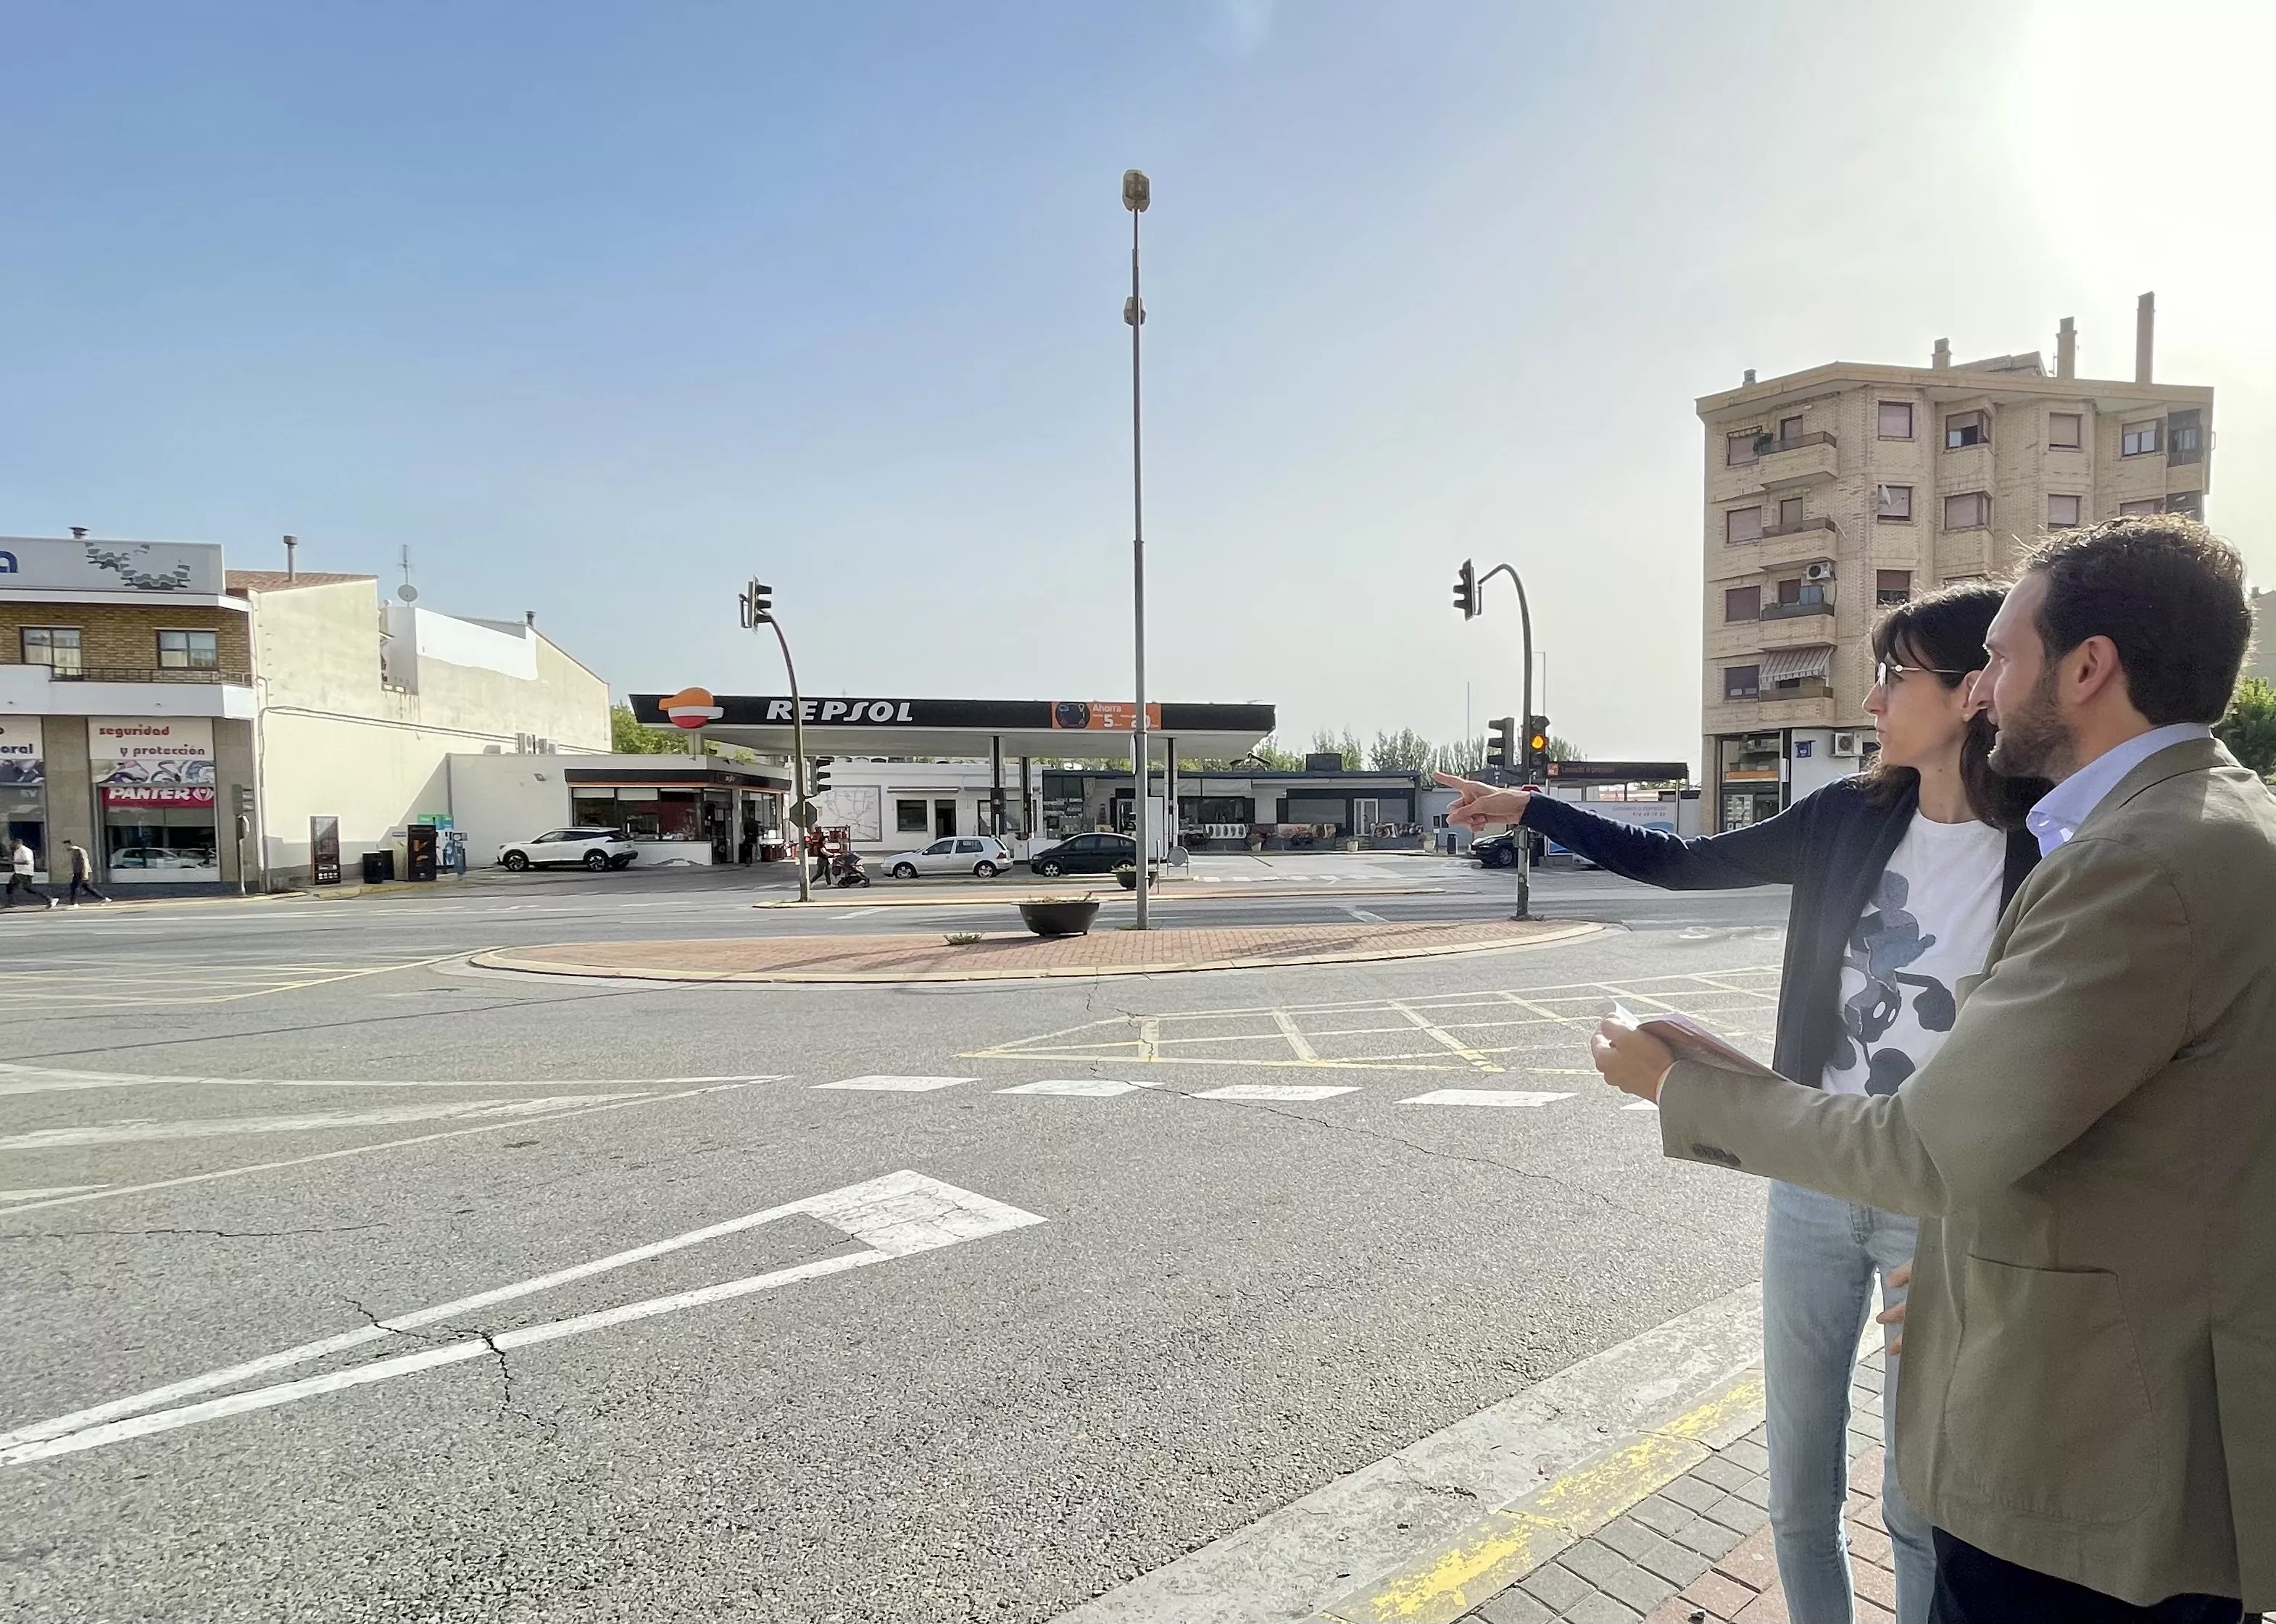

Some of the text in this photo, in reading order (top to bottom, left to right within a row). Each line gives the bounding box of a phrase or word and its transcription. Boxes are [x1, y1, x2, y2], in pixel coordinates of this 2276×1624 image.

[765, 699, 913, 723] REPSOL
[1092, 704, 1122, 713] Ahorra
[1103, 714, 1114, 728] 5
[99, 724, 170, 738] seguridad
[120, 744, 205, 756] y protección
[108, 786, 190, 801] PANTER
